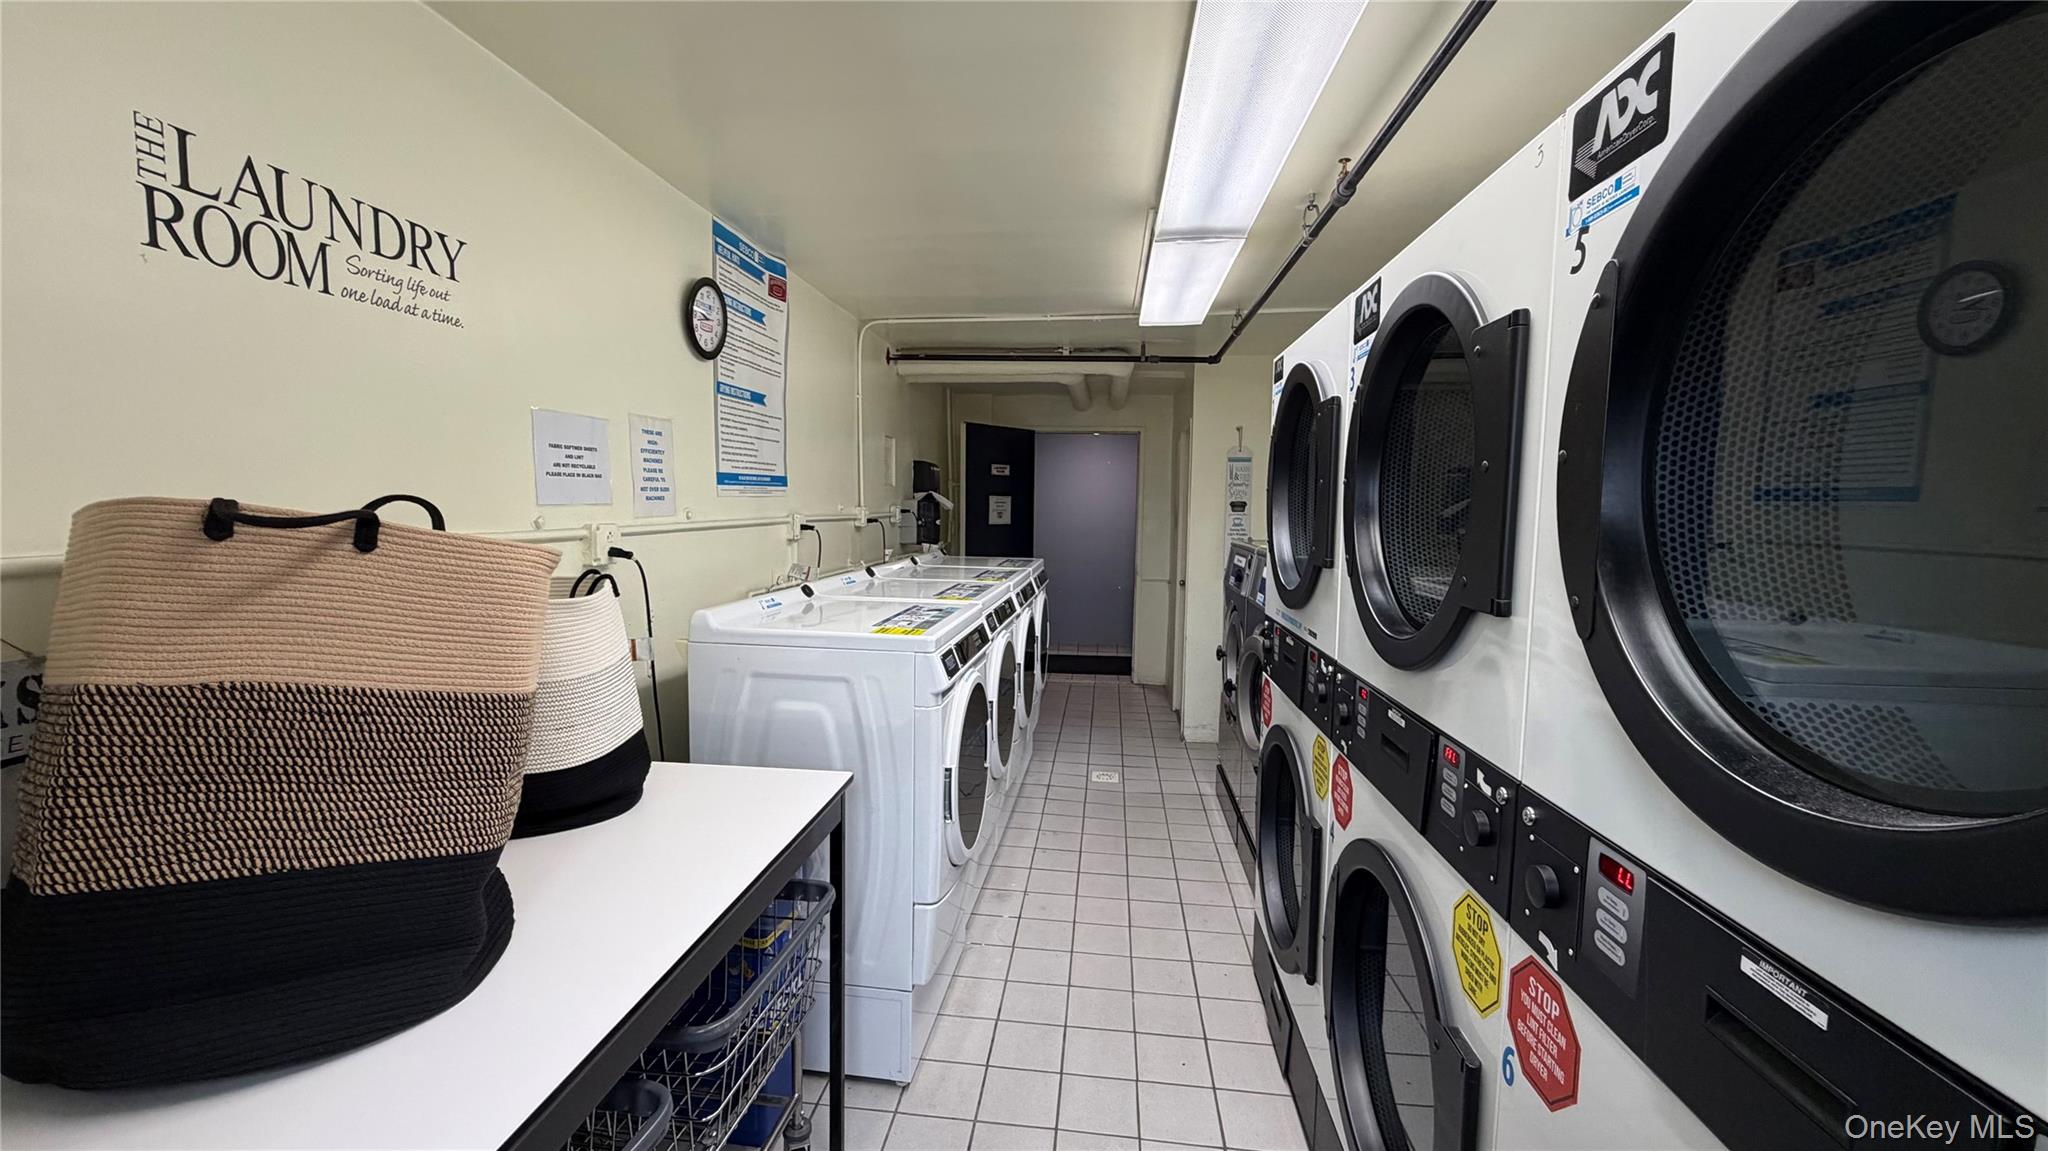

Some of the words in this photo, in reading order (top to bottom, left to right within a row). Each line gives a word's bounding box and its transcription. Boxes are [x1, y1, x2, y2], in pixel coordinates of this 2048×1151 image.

[1591, 50, 1661, 151] ADC
[133, 110, 167, 182] THE
[167, 123, 467, 283] LAUNDRY
[1586, 184, 1614, 209] SEBCO
[136, 181, 335, 296] ROOM
[1570, 226, 1590, 274] 5
[346, 255, 404, 294] Sorting
[406, 277, 428, 299] life
[429, 288, 451, 301] out
[341, 287, 369, 302] one
[370, 289, 403, 312] load
[404, 304, 420, 316] at
[421, 308, 432, 319] a
[432, 309, 464, 328] time.
[1618, 867, 1632, 890] LL
[1466, 903, 1488, 935] STOP
[1529, 975, 1560, 1020] STOP
[1760, 960, 1808, 997] IMPORTANT
[1521, 987, 1531, 1010] YOU
[1531, 1001, 1547, 1027] MUST
[1547, 1019, 1567, 1051] CLEAN
[1526, 1012, 1538, 1035] LINT
[1538, 1027, 1558, 1059] FILTER
[1502, 1046, 1515, 1087] 6
[1517, 1018, 1538, 1051] BEFORE
[1537, 1043, 1565, 1085] STARTING
[1529, 1050, 1548, 1081] DRYER
